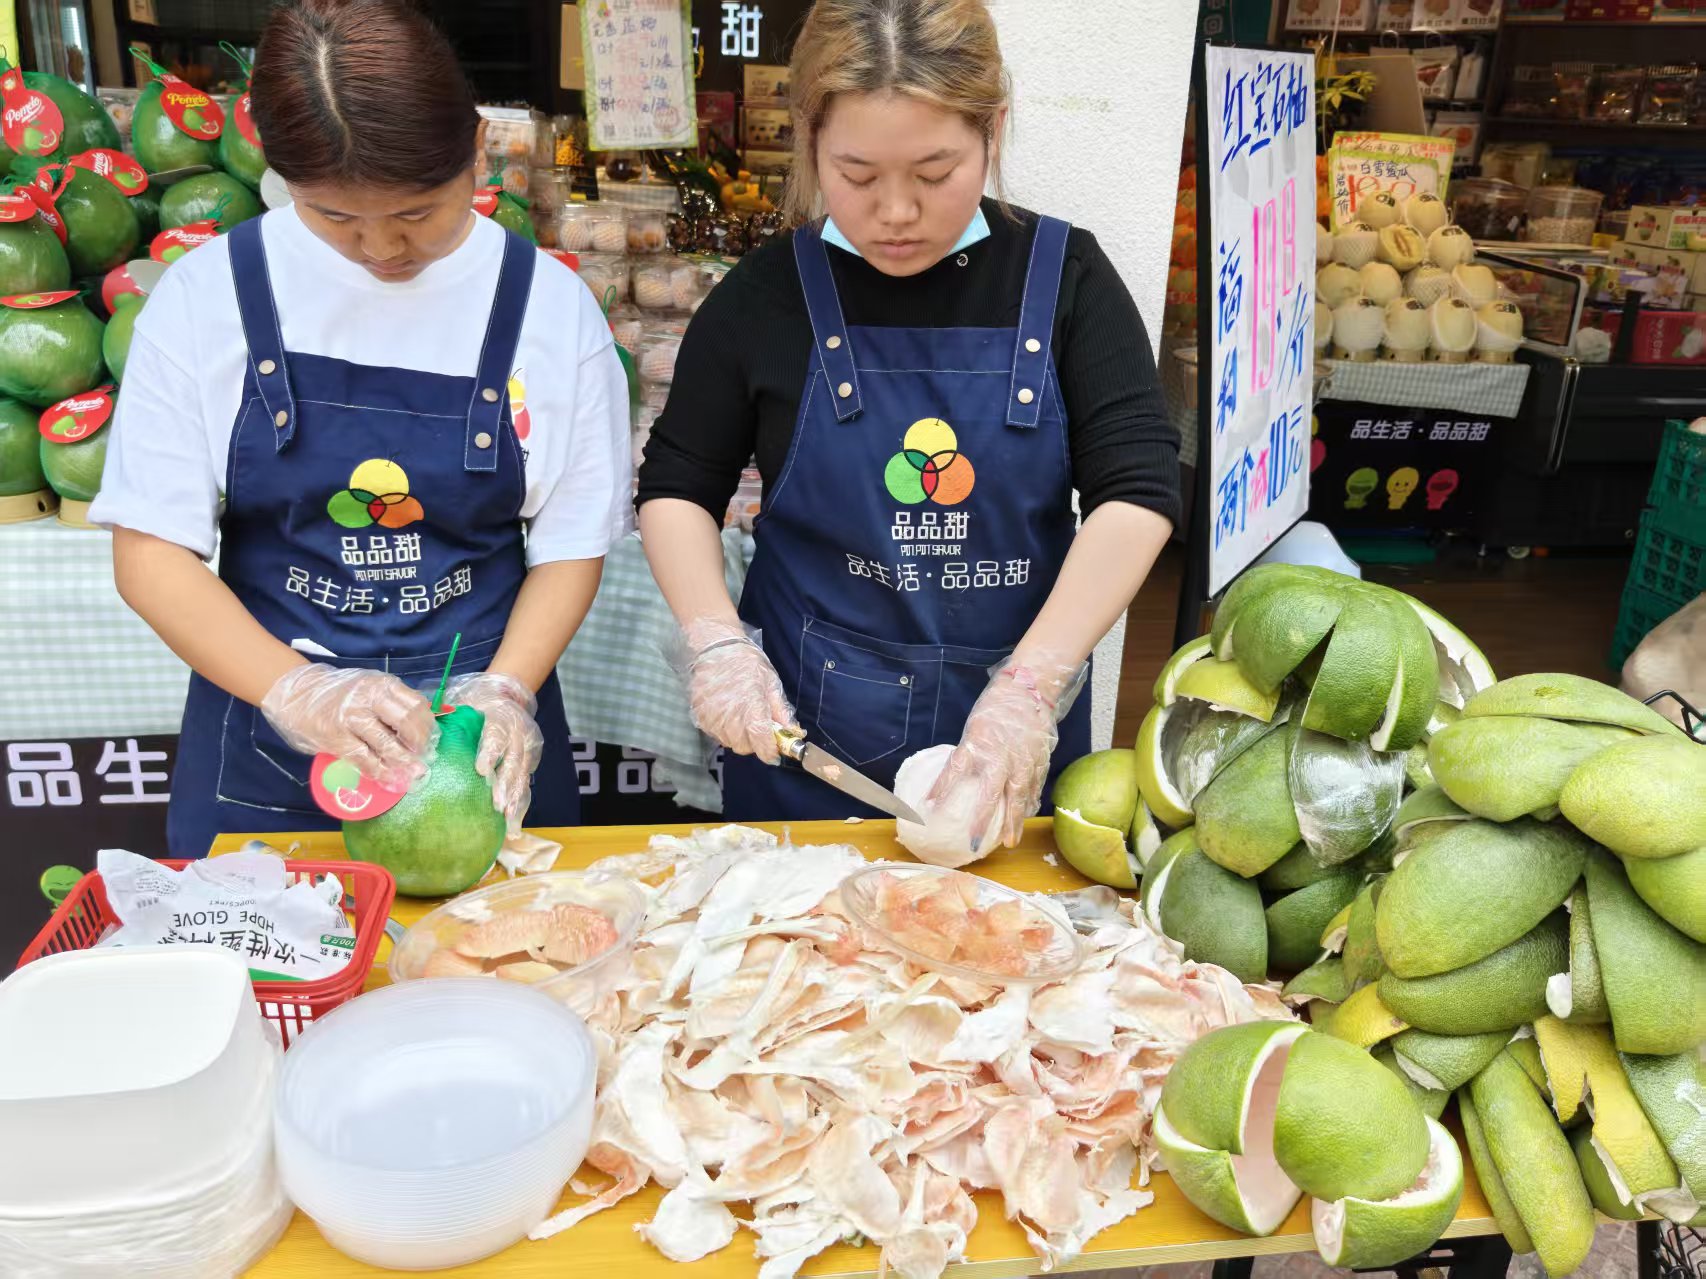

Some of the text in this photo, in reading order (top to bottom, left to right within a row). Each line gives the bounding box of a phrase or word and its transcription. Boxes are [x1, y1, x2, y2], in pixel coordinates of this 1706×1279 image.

[5, 95, 43, 128] Pomelo
[167, 92, 210, 108] Pomelo
[92, 152, 109, 175] omelo
[1350, 419, 1491, 441] 品生活·品品甜
[892, 511, 971, 541] 品品甜
[341, 532, 422, 566] 品品甜
[846, 553, 1031, 593] 品生活·品品甜
[285, 563, 472, 614] 品生活·品品甜
[173, 910, 275, 934] HDPE GLOVE
